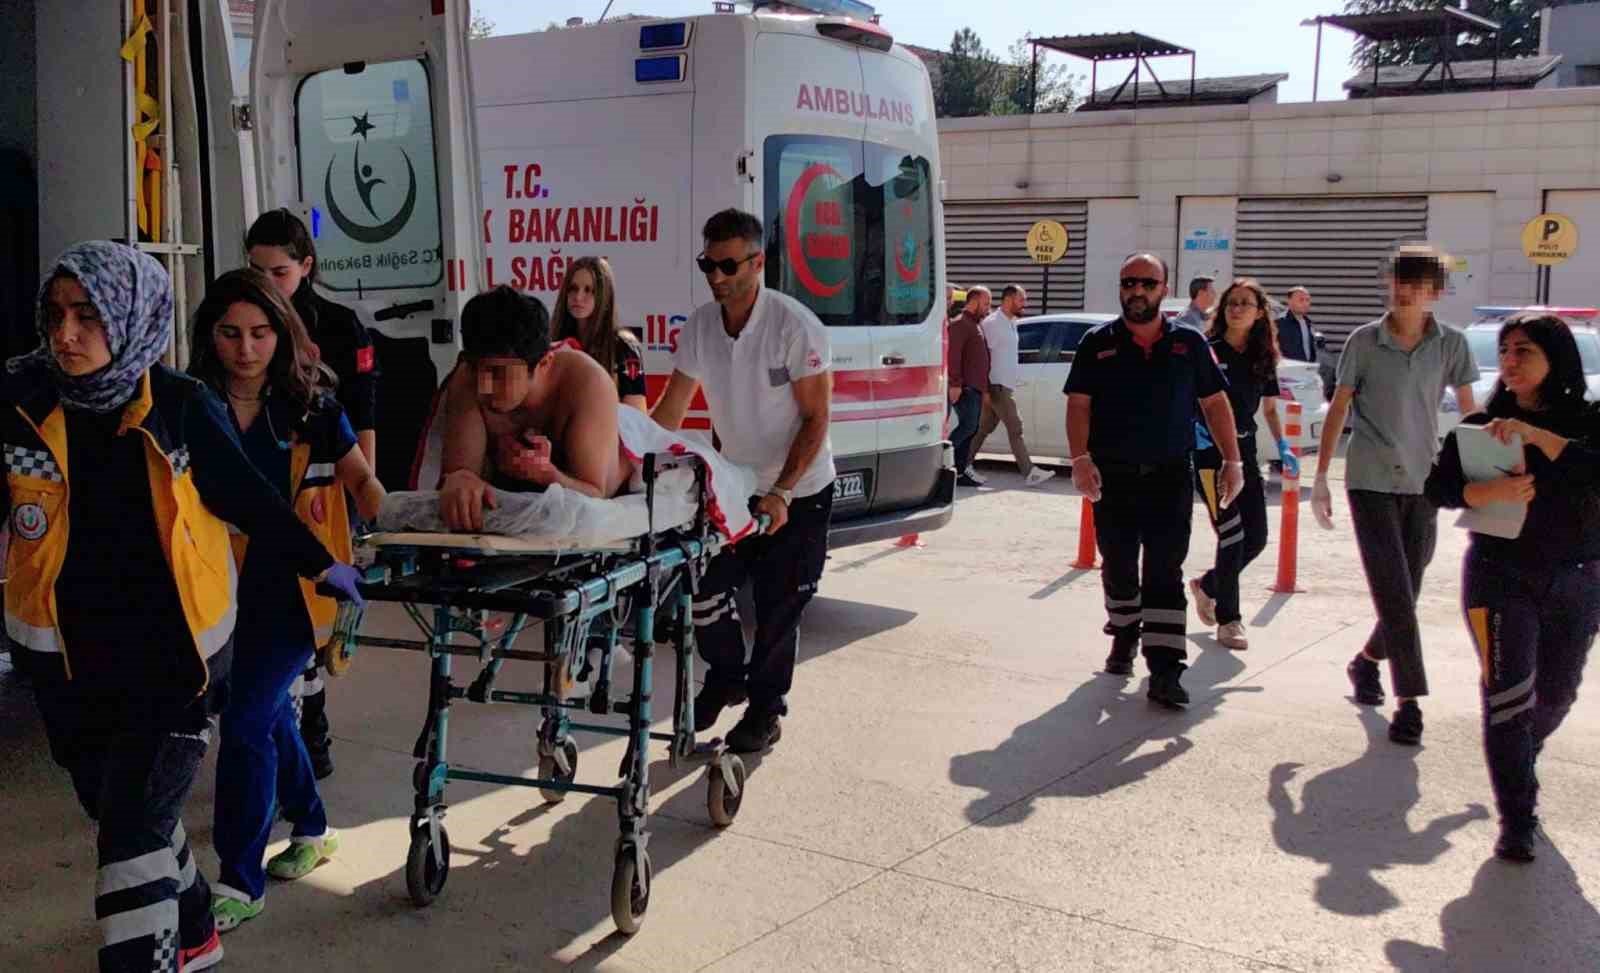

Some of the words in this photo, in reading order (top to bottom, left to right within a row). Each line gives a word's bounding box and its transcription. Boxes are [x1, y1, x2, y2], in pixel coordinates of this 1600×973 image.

[796, 83, 914, 126] AMBULANS
[504, 163, 549, 198] T.C.
[509, 198, 659, 243] BAKANLIĞI
[1543, 219, 1560, 241] P
